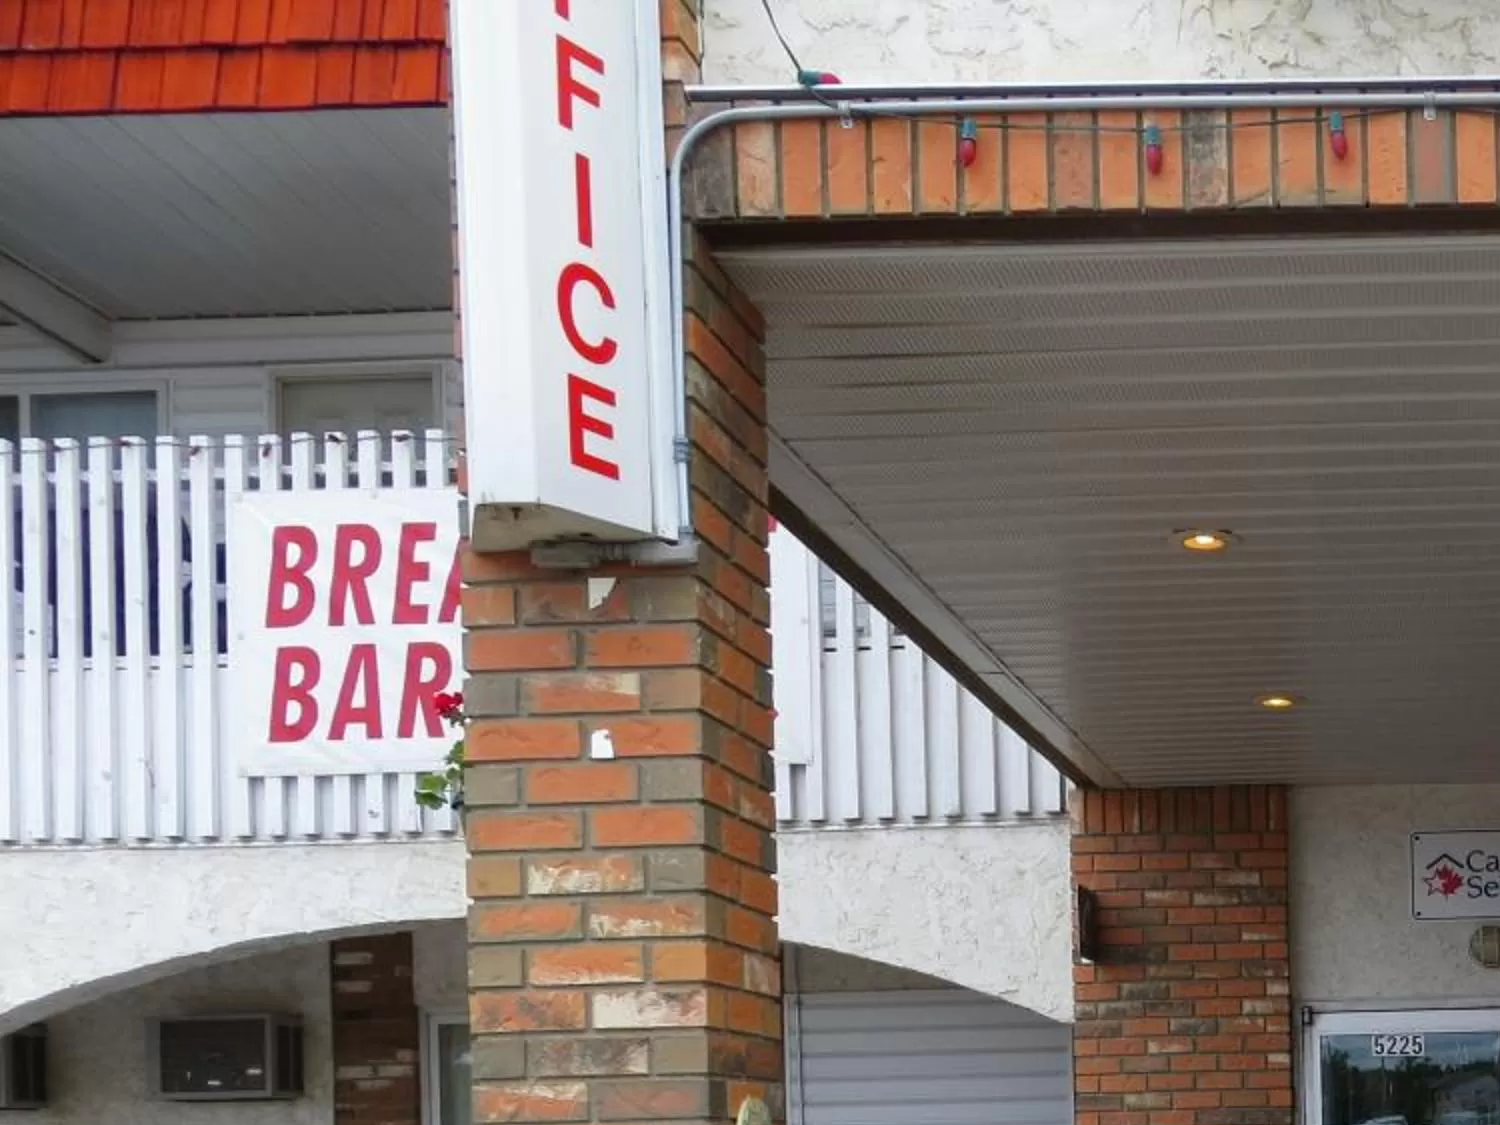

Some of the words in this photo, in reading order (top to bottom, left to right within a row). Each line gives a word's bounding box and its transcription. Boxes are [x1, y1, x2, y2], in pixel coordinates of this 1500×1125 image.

[555, 0, 621, 481] FICE
[268, 642, 452, 743] BAR
[1374, 1034, 1423, 1055] 5225
